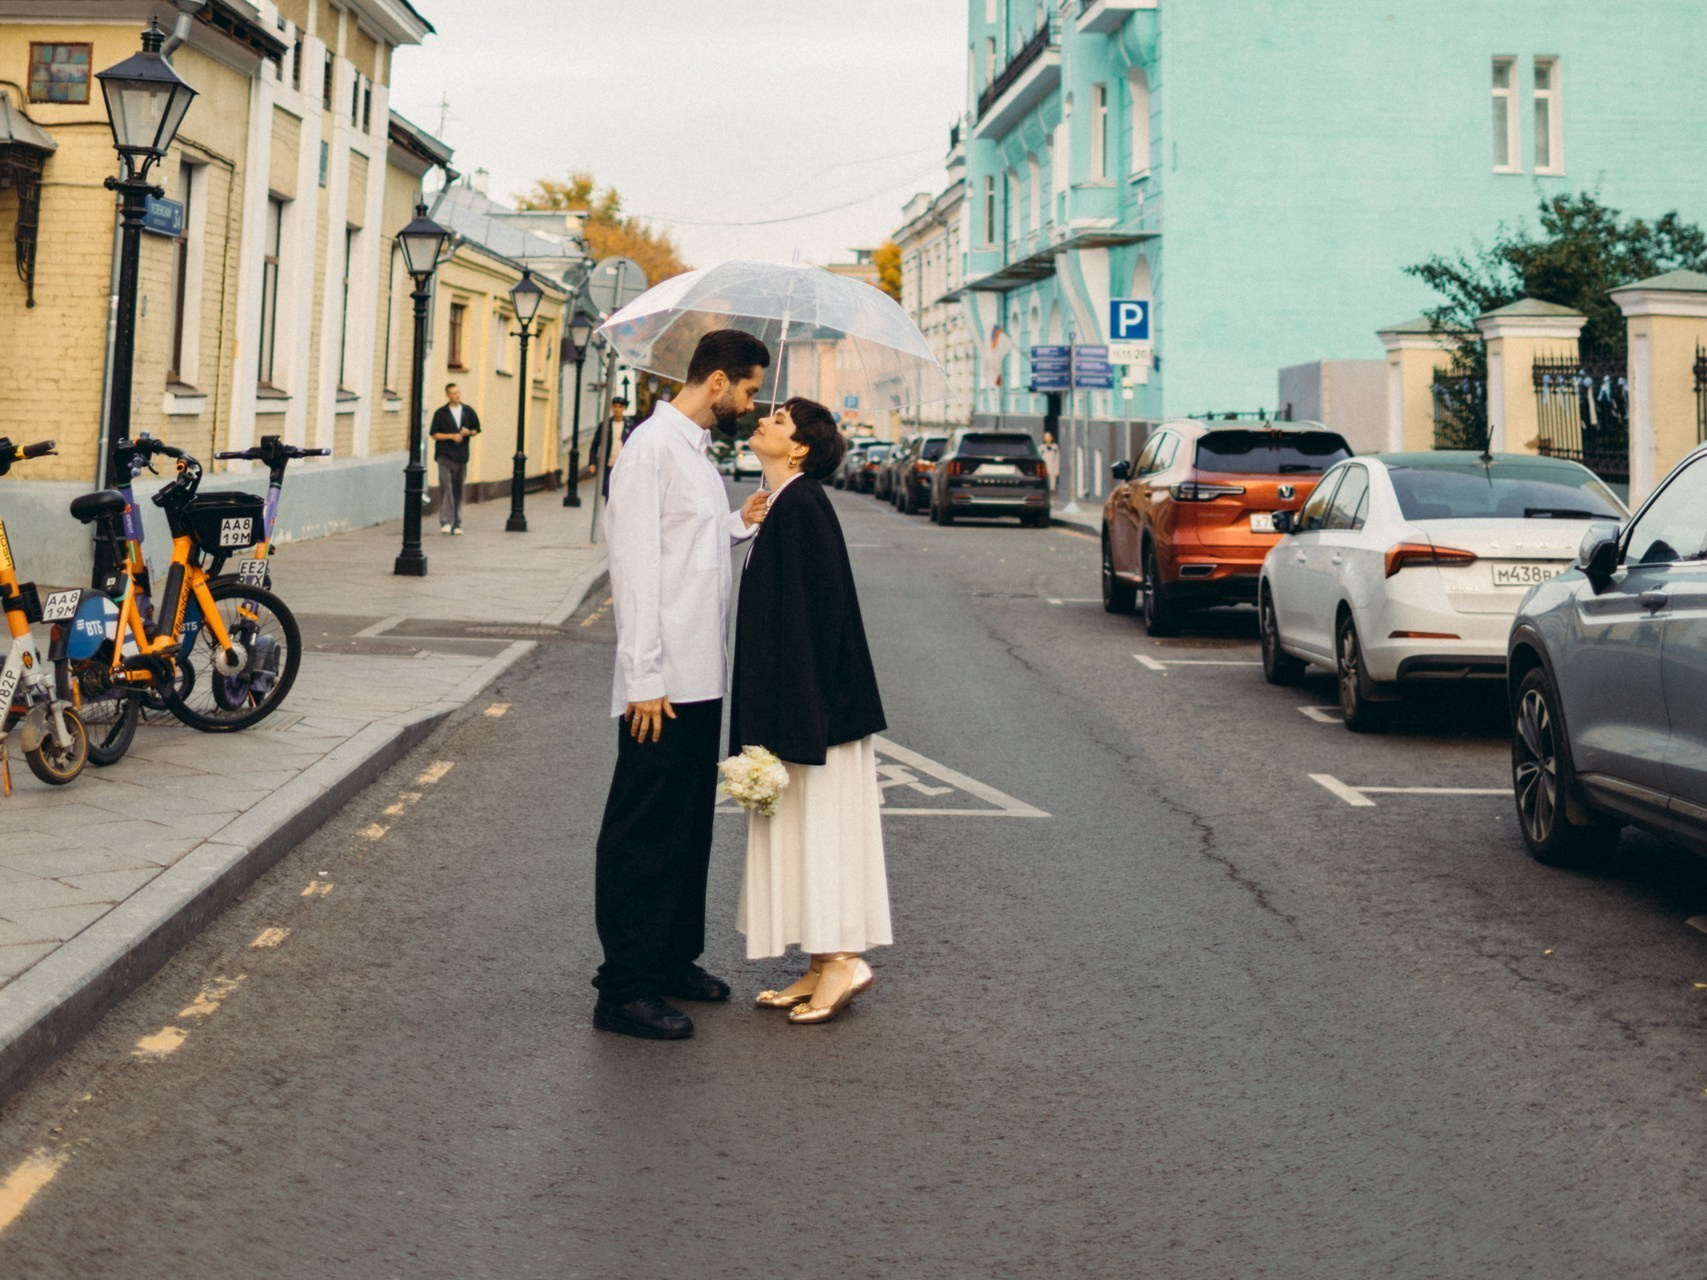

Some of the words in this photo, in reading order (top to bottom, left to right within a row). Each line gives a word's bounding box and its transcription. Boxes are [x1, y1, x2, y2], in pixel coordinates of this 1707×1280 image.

[1119, 303, 1143, 337] P
[222, 519, 251, 532] АА8
[223, 532, 250, 544] 19М
[47, 592, 78, 606] АА8
[47, 605, 76, 618] 19М
[85, 620, 104, 636] ВТБ
